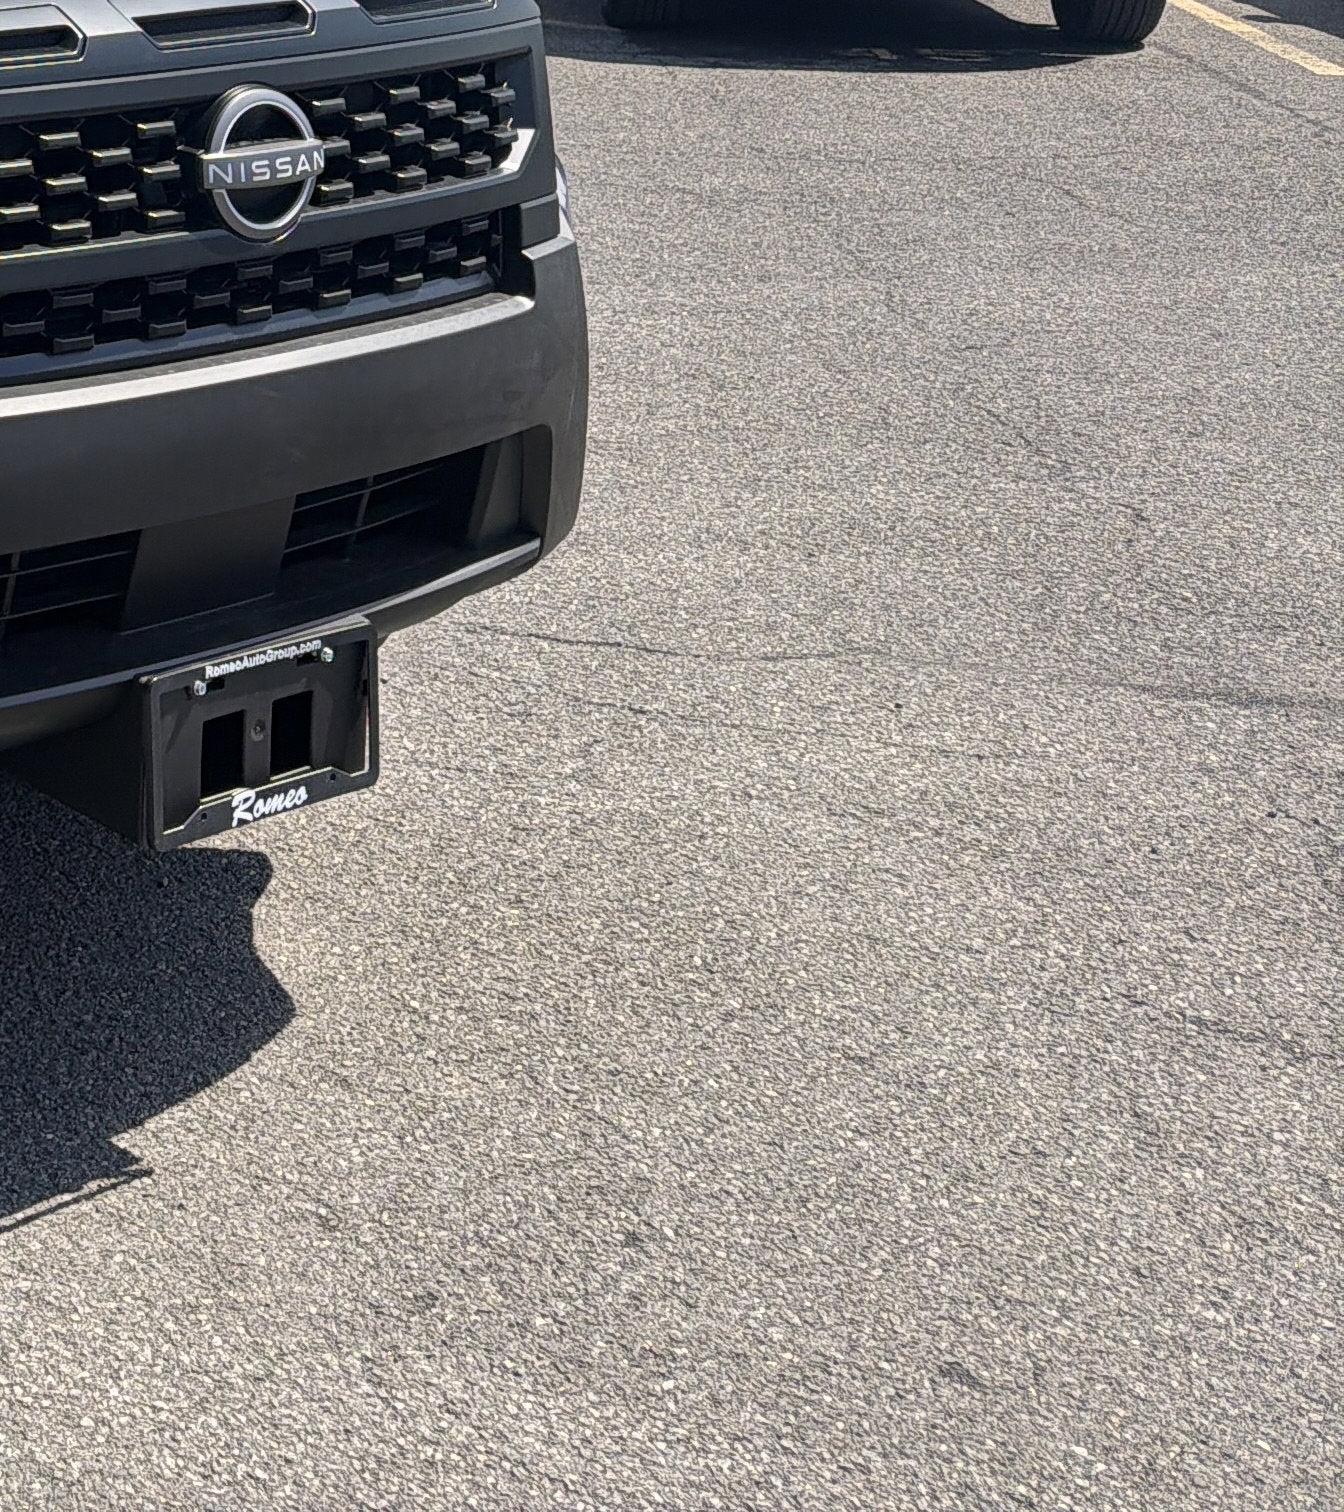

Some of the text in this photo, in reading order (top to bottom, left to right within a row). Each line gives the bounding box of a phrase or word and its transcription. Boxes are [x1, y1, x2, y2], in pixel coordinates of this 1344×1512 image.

[208, 148, 325, 185] NISSAN
[205, 639, 322, 679] RomeoAutoGroup.com
[231, 785, 308, 827] Romeo
